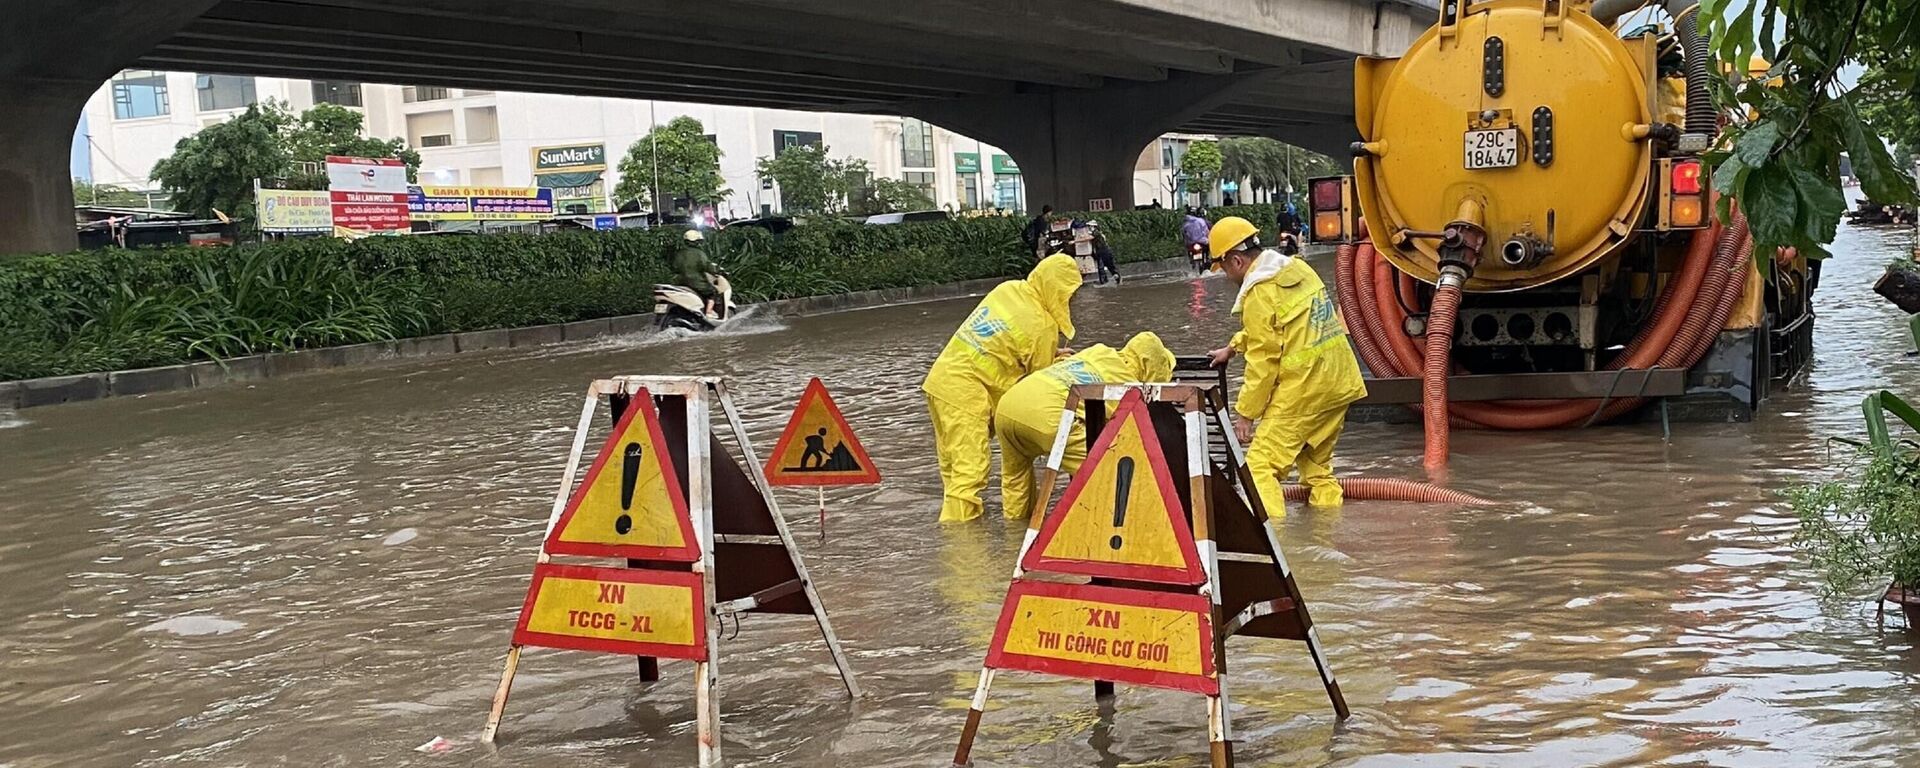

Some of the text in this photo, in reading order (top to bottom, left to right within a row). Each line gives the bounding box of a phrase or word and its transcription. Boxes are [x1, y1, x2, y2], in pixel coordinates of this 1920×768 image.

[1476, 131, 1504, 149] 29C
[540, 147, 595, 164] SunMart
[1467, 148, 1515, 167] 184.47
[373, 194, 394, 202] MOTOR
[433, 188, 460, 196] GARA
[464, 187, 471, 196] Ô
[474, 187, 485, 196] TÔ
[597, 583, 625, 604] XN
[568, 610, 616, 630] TCCG
[631, 615, 654, 633] XL
[1086, 608, 1121, 629] XN
[1037, 630, 1169, 663] THI CÔNG CƠ GIỚI
